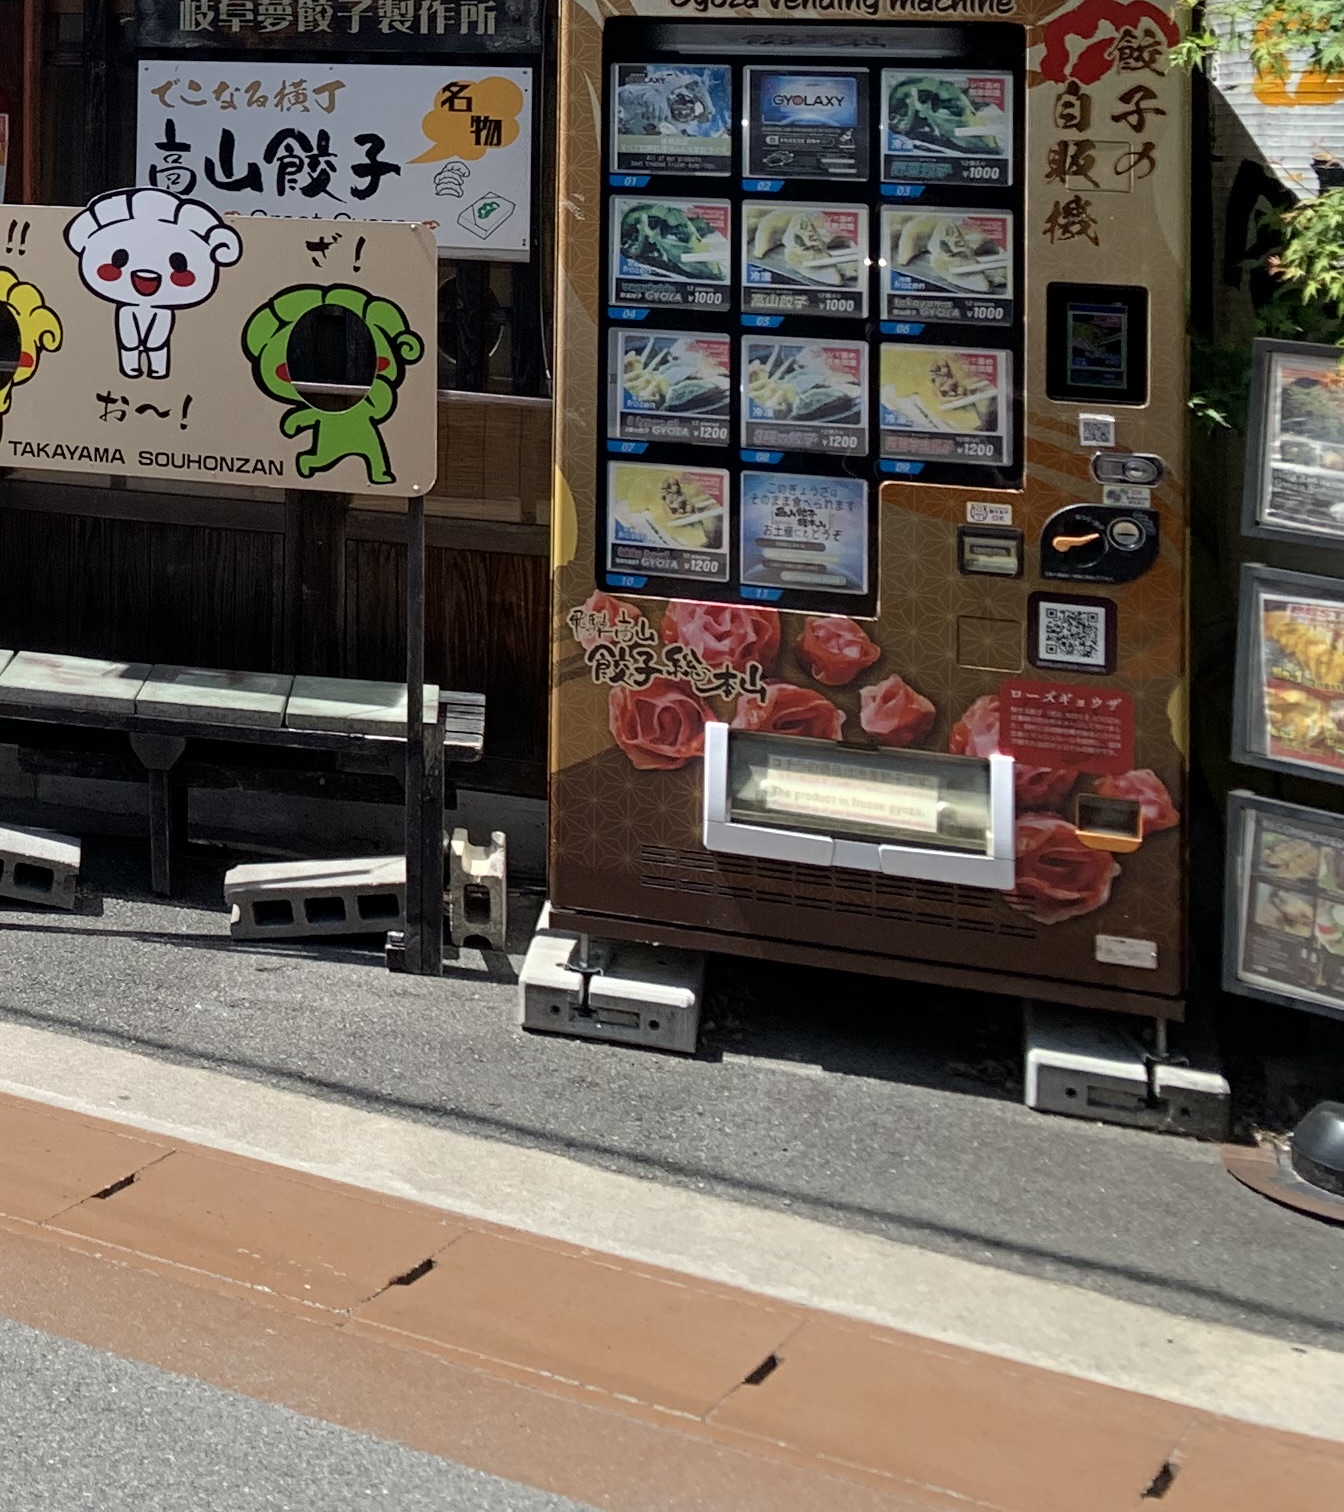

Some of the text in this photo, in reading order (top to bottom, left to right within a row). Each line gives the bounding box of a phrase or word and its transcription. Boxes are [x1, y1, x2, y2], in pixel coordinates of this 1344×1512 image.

[151, 78, 347, 114] でこなる横丁
[441, 81, 502, 147] 名物
[773, 95, 844, 106] GYOLAXY
[1107, 28, 1166, 179] 餃子の
[149, 118, 401, 203] 高山餃子
[1042, 80, 1101, 247] 自販機
[9, 440, 284, 476] TAKAYAMA SOUHONZAN
[588, 644, 767, 703] 餃子総本山
[1011, 690, 1122, 710] ローズギョウザ
